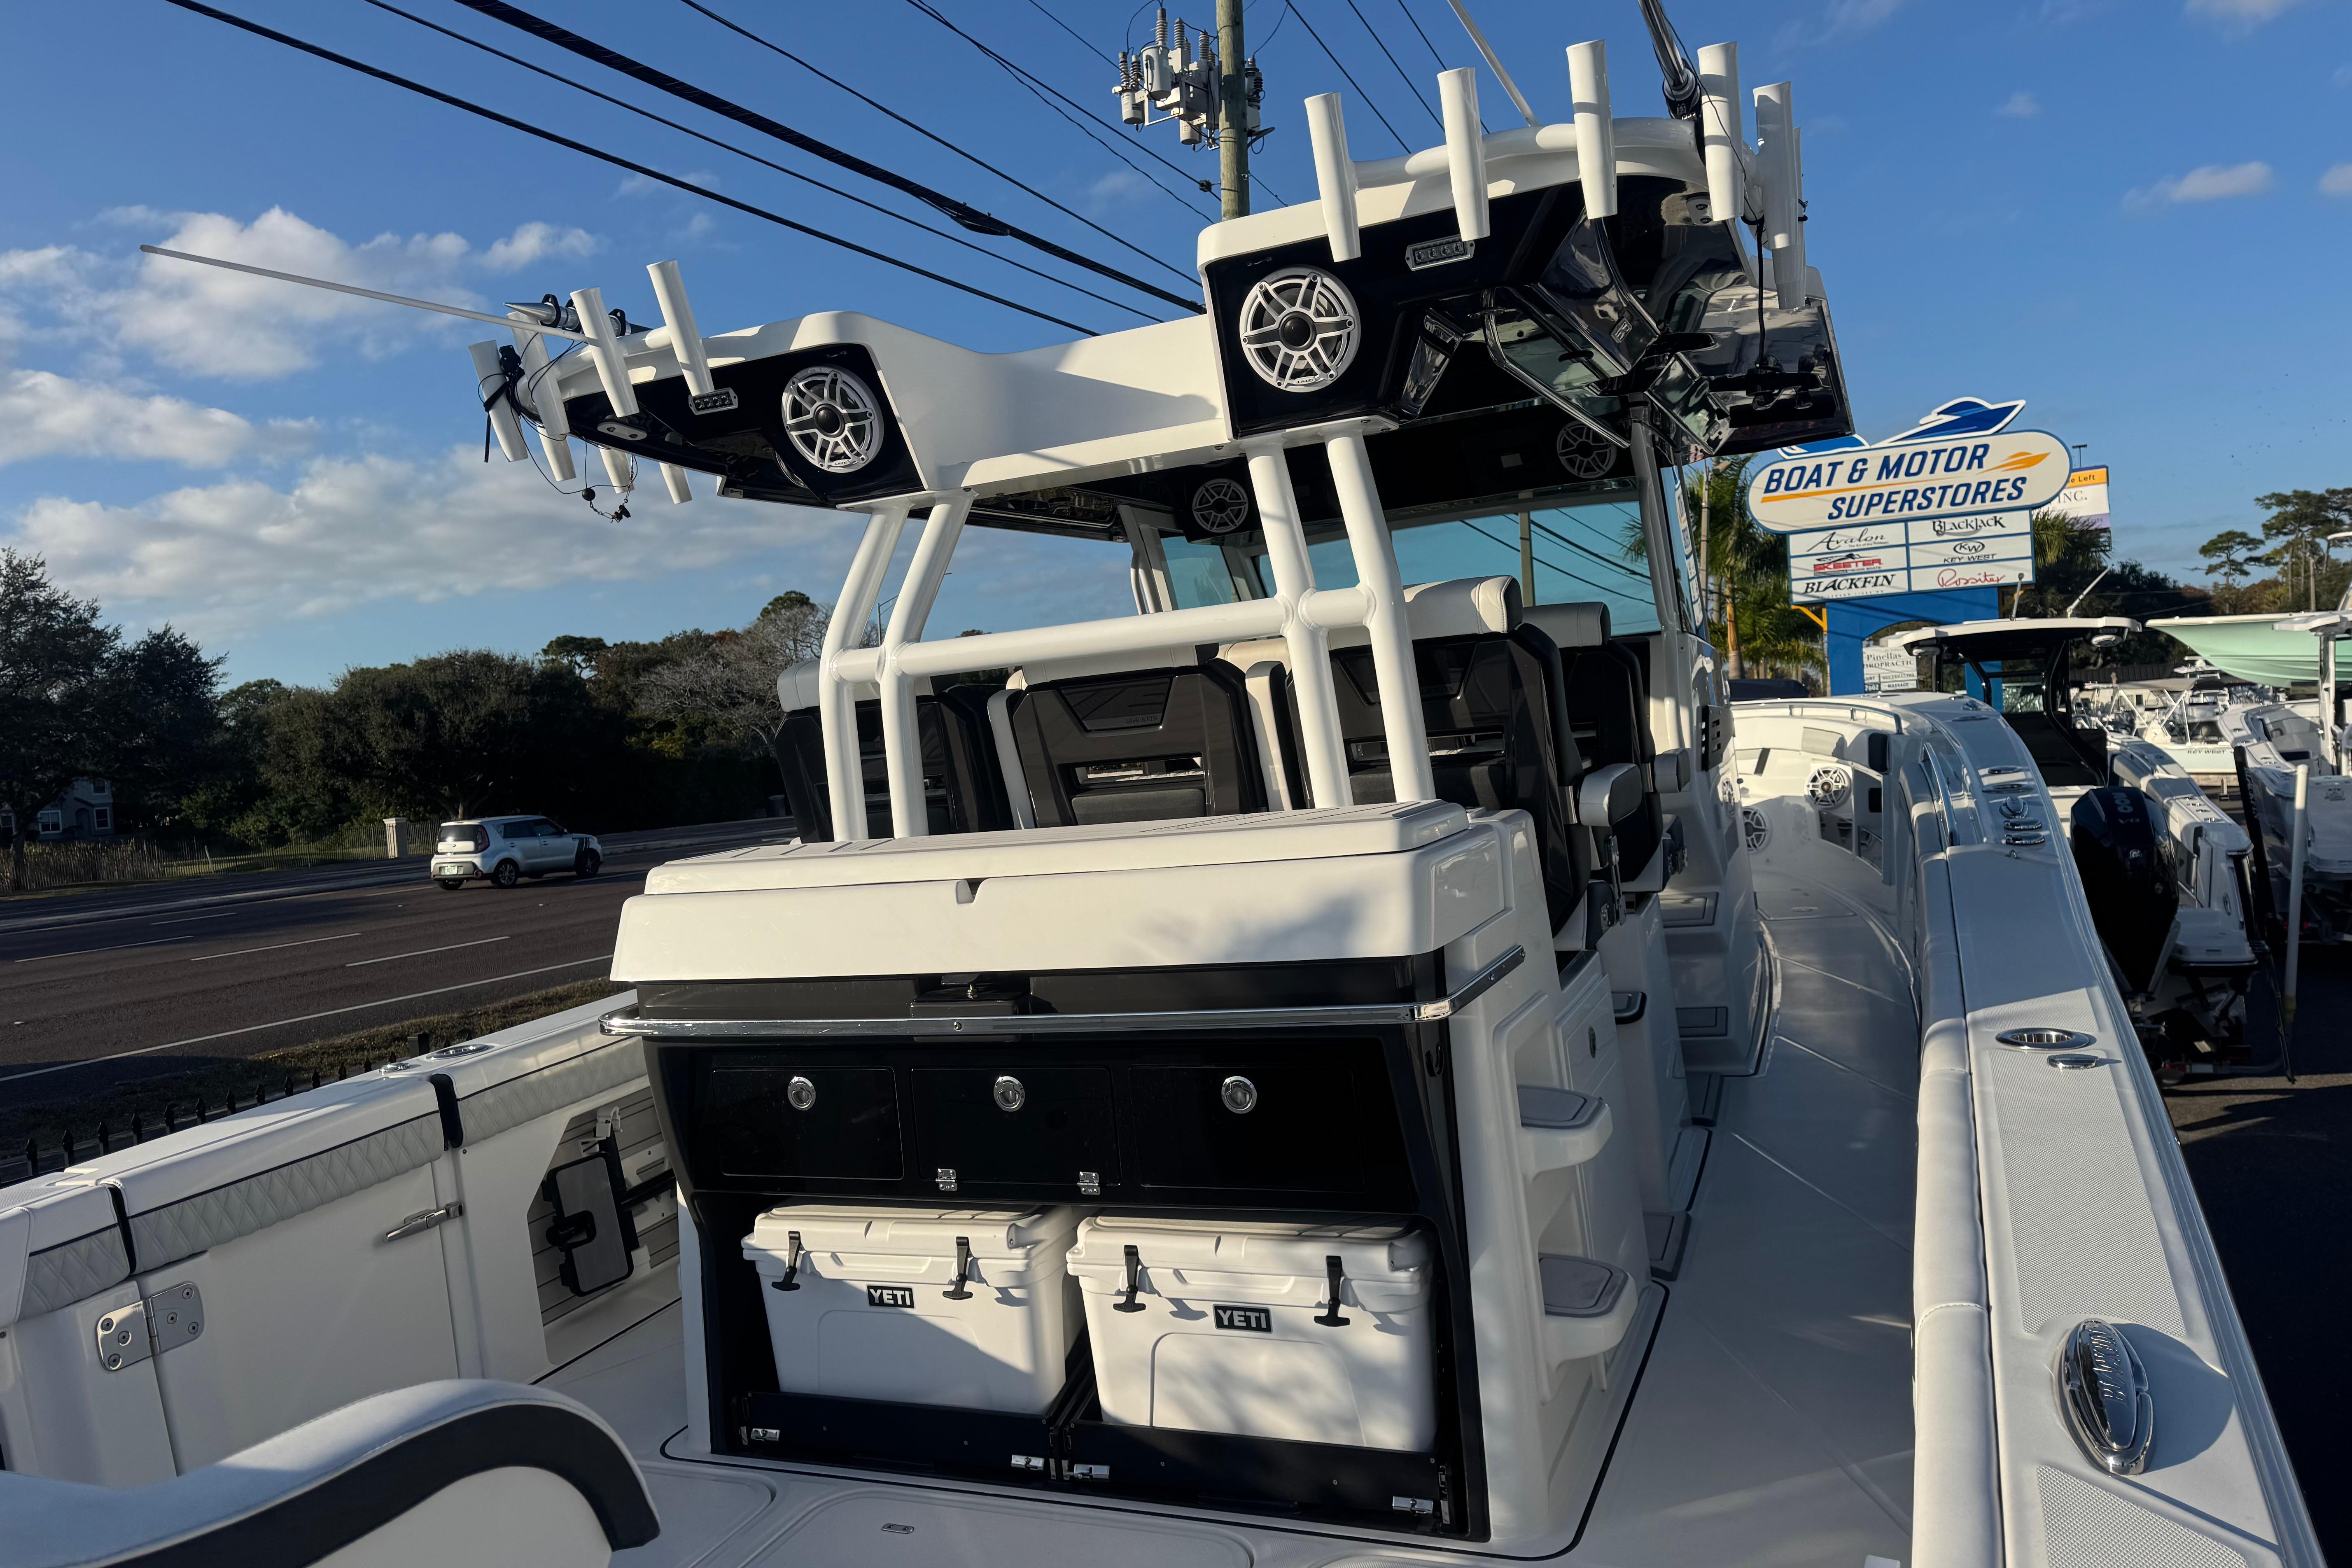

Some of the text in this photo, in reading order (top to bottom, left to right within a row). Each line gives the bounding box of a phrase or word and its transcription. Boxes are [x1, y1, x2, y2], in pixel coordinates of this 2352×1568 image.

[1764, 444, 1990, 494] BOAT & MOTOR
[1827, 476, 2027, 520] SUPERSTORES
[1806, 528, 1885, 552] Avalon
[1813, 558, 1881, 572] SKEETER
[1967, 553, 1997, 561] WEST
[1803, 574, 1896, 594] BLACKFIN
[1938, 568, 2006, 587] Rossiter
[1867, 653, 1902, 661] Pinellas
[869, 1288, 911, 1305] YETI
[1217, 1309, 1267, 1328] YETI
